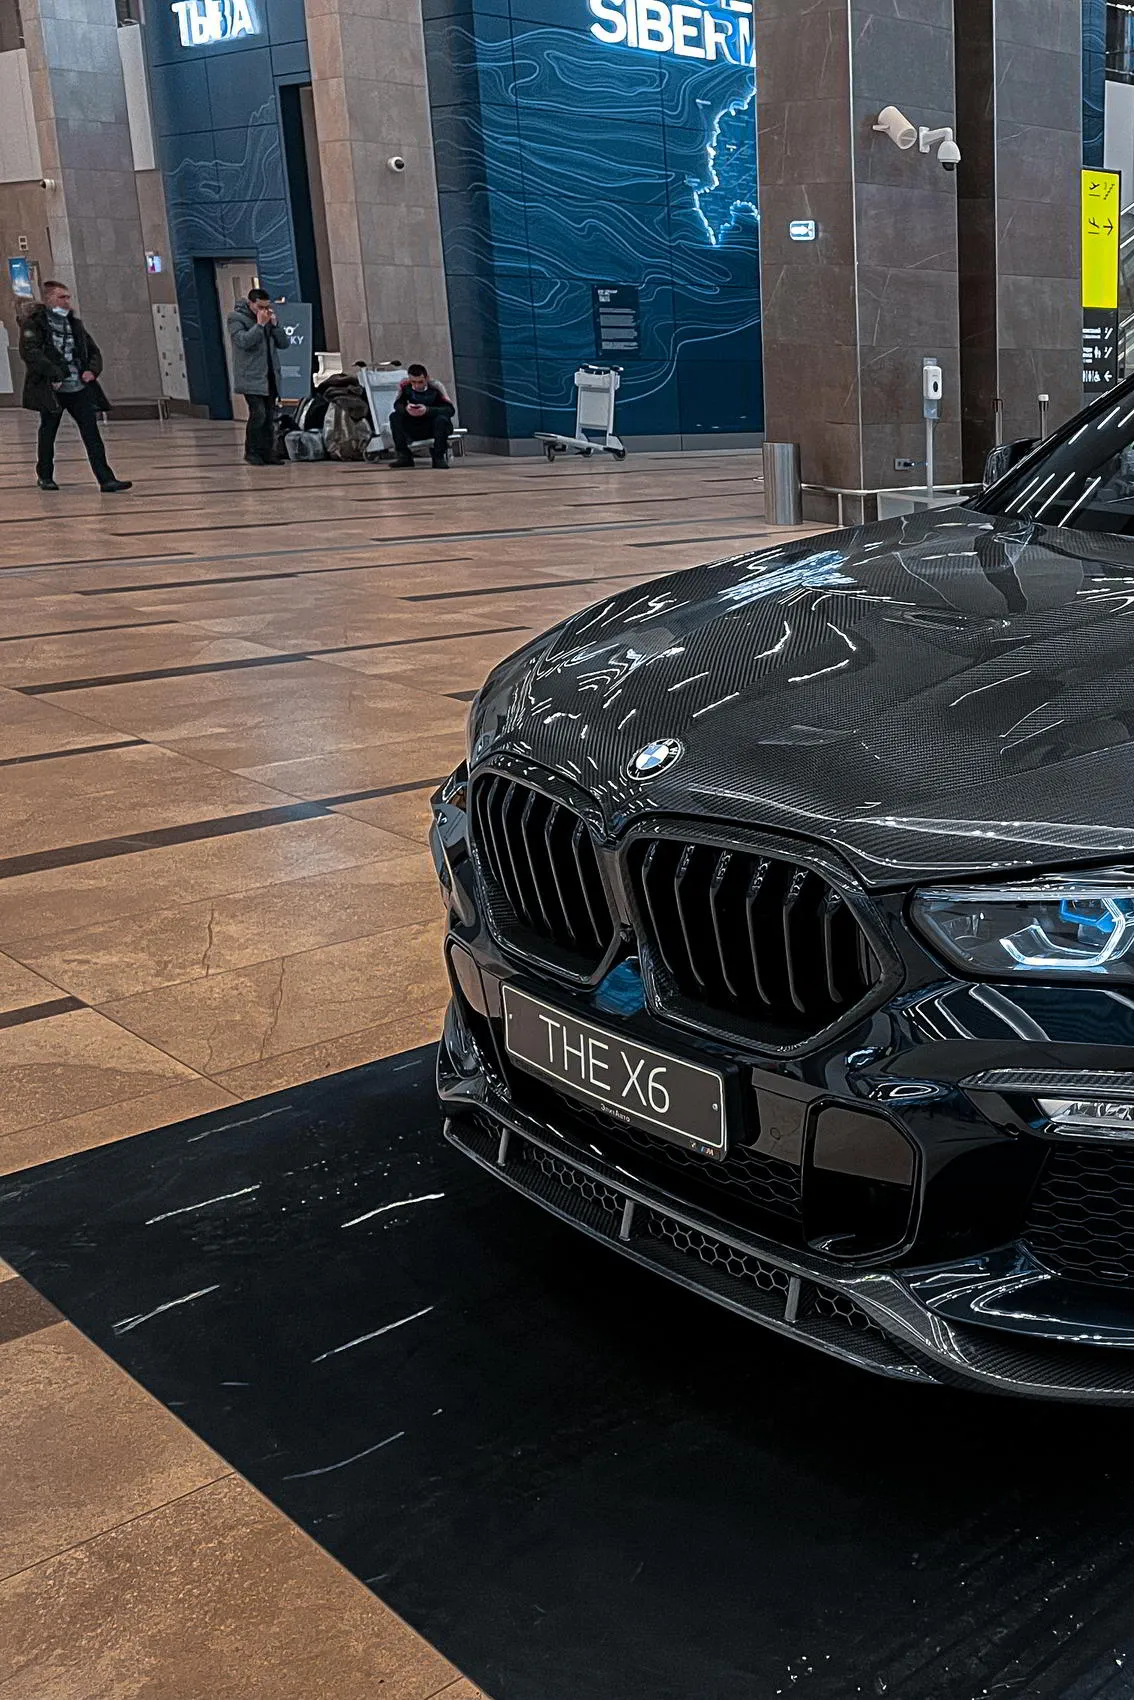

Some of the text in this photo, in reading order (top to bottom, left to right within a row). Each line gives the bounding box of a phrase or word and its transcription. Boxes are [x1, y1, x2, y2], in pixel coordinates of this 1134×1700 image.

[588, 0, 757, 68] SIBERI
[538, 1014, 670, 1114] THE X6
